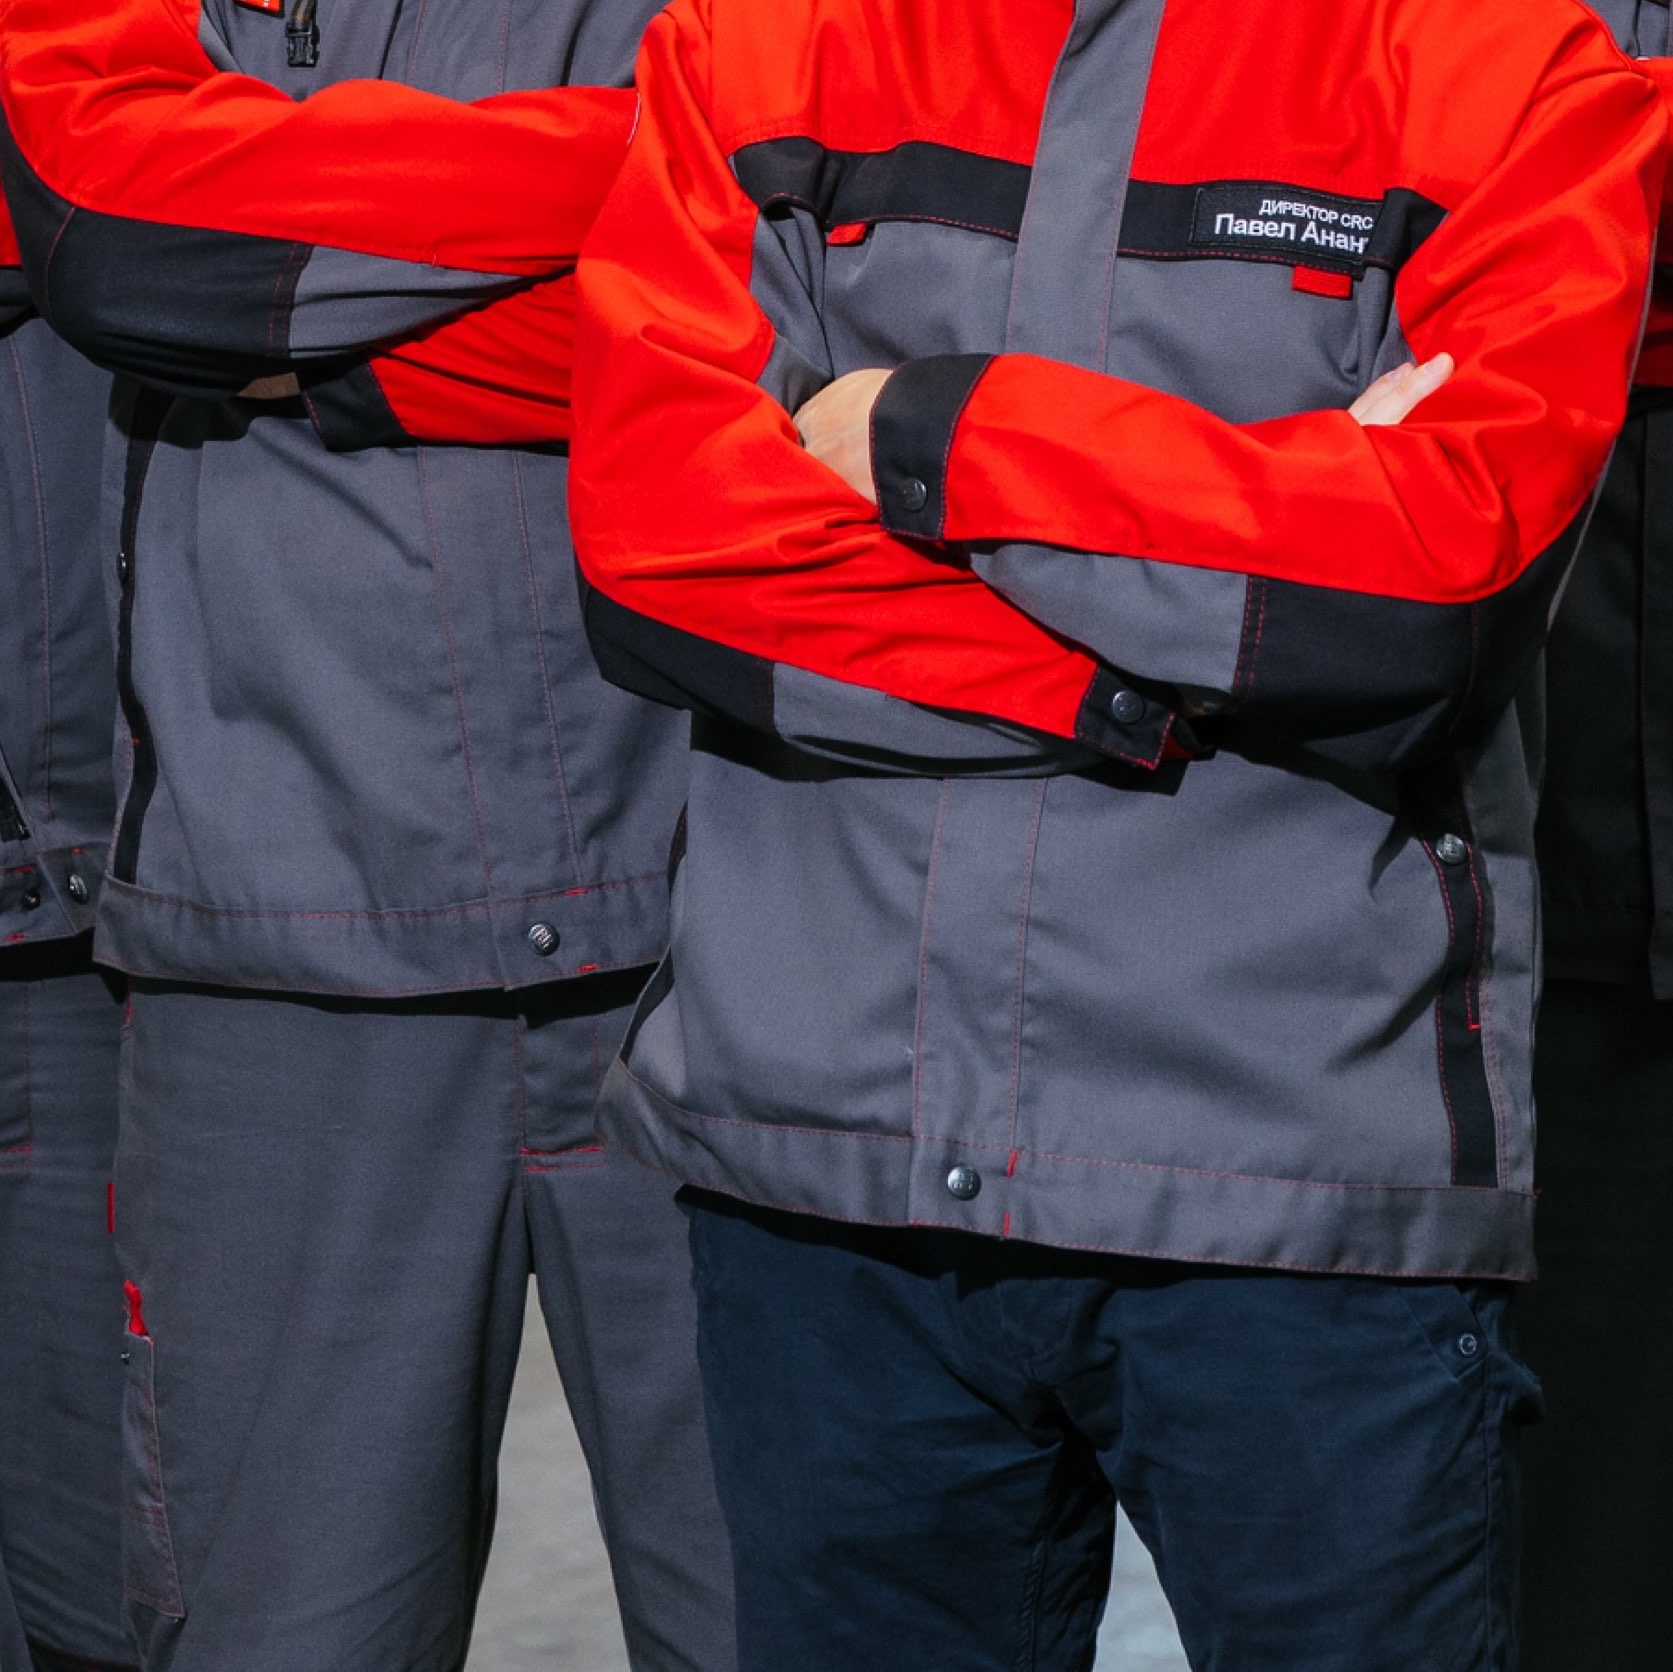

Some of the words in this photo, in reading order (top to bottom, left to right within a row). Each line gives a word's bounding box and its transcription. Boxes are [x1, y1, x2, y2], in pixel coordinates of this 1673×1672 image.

[1259, 199, 1339, 224] ДИРЕКТОР
[1214, 213, 1296, 240] Павел
[1300, 221, 1369, 255] Анан
